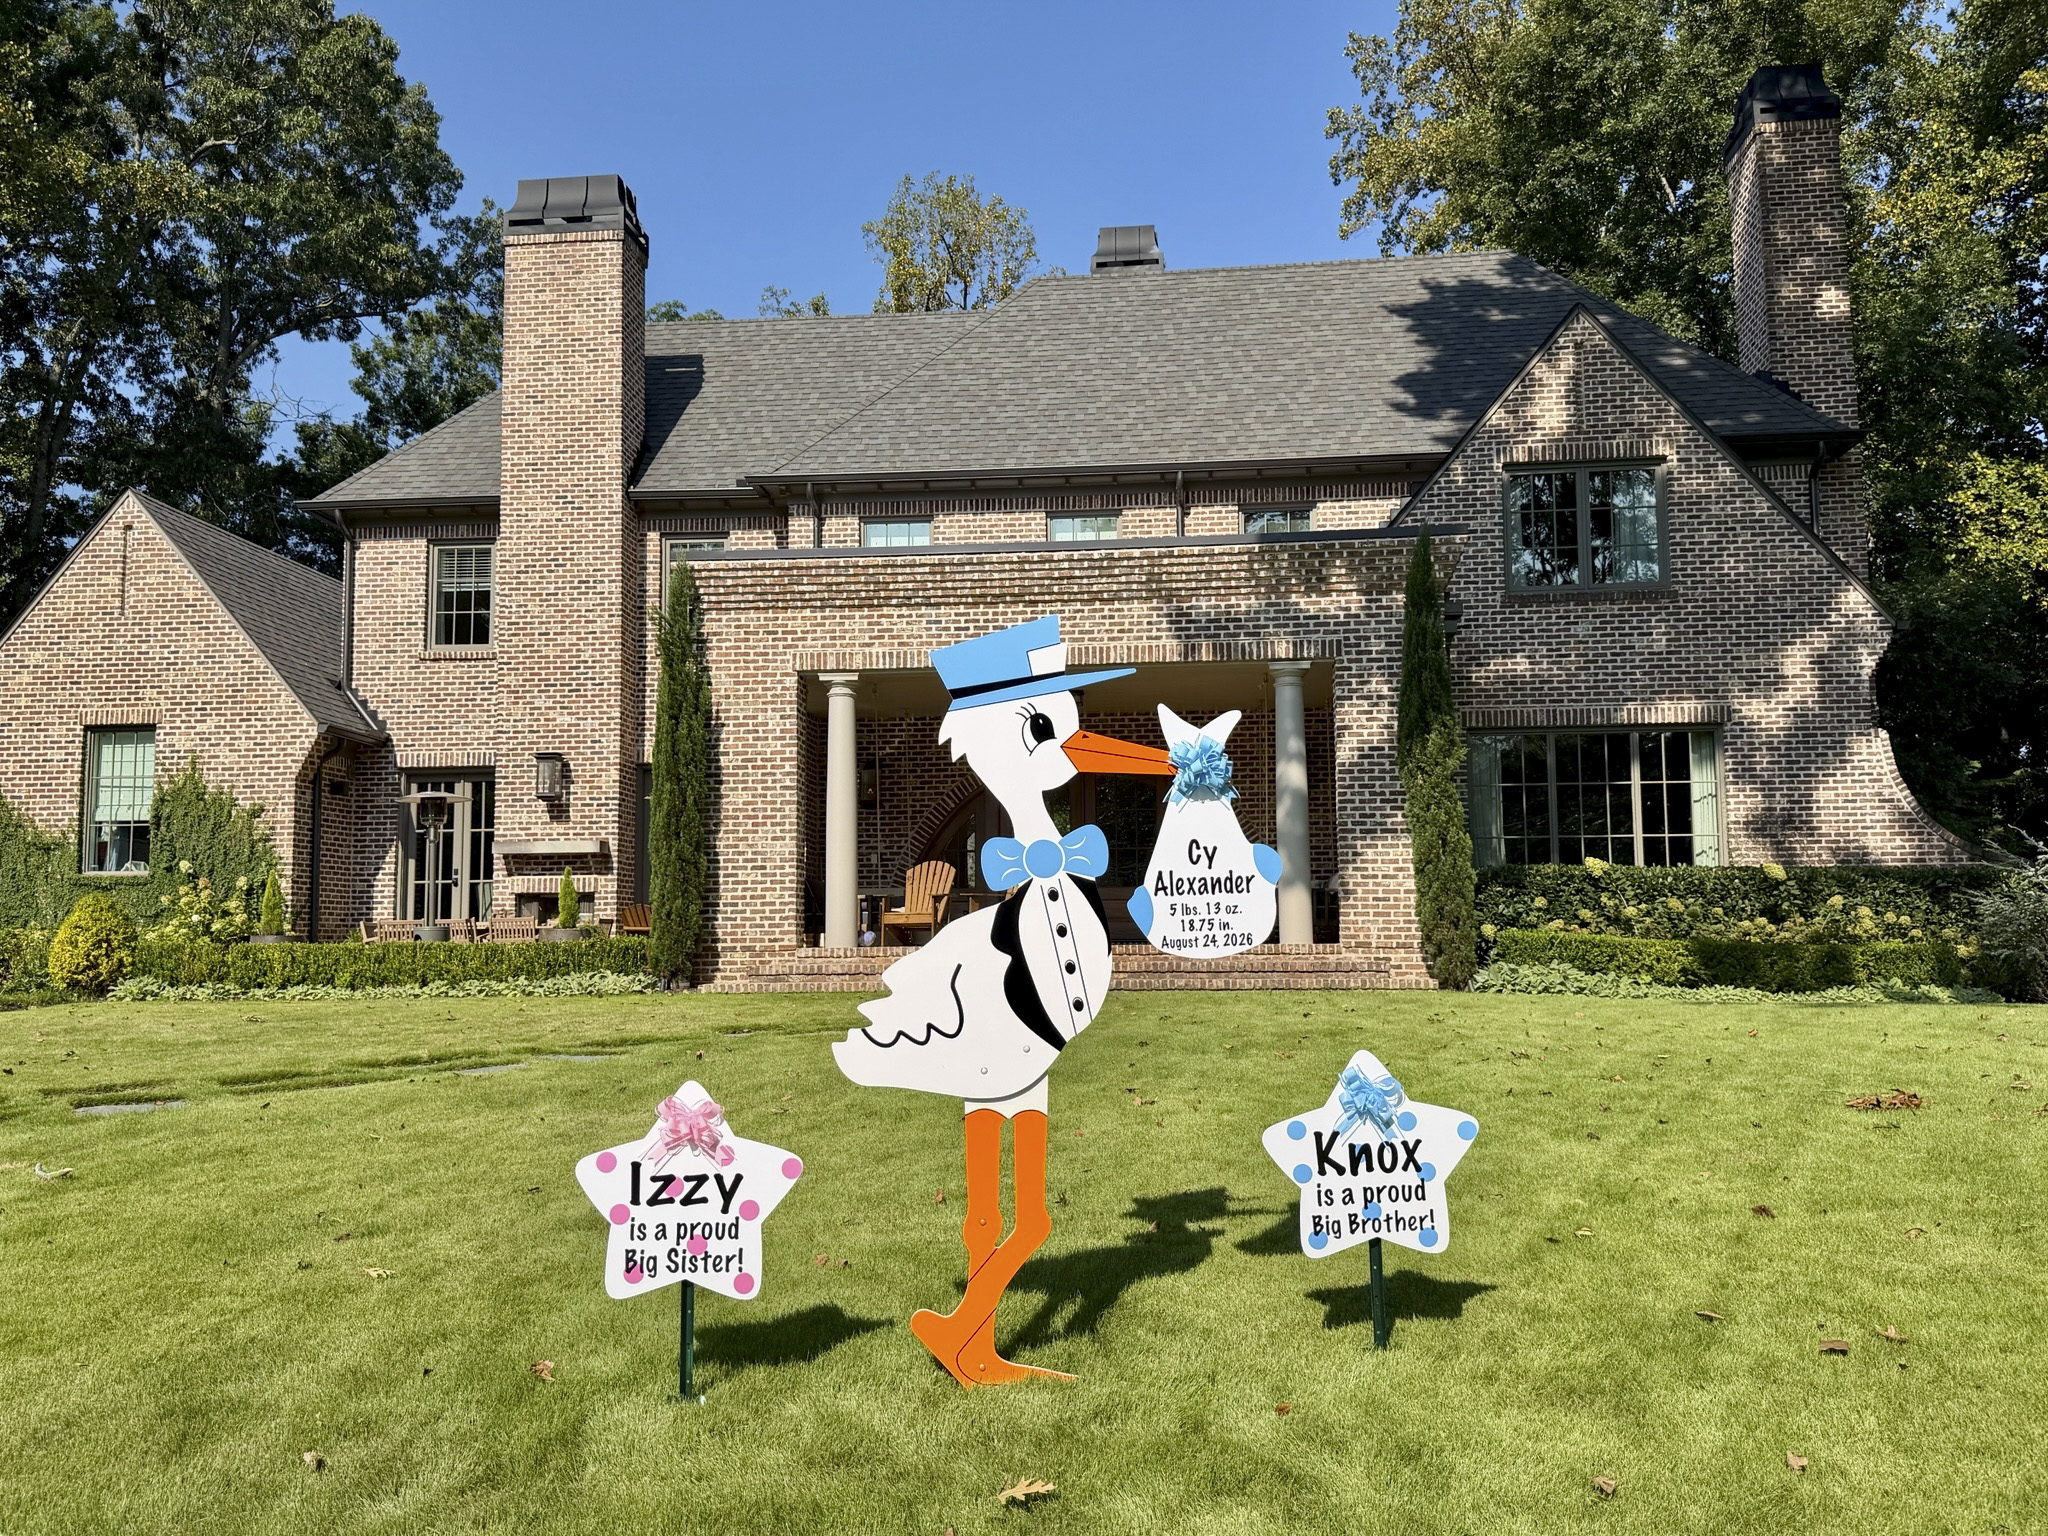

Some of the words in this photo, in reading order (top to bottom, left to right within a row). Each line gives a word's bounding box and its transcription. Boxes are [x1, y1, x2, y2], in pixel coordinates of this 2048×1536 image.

[1188, 839, 1218, 870] Cy
[1154, 870, 1255, 897] Alexander
[1169, 903, 1178, 917] 5
[1181, 903, 1201, 916] lbs.
[1206, 902, 1221, 915] 13
[1225, 904, 1243, 915] oz.
[1181, 918, 1215, 932] 18.75
[1219, 919, 1234, 931] in.
[1161, 935, 1199, 951] August
[1203, 934, 1219, 948] 24,
[1223, 933, 1253, 946] 2026
[1313, 1131, 1422, 1177] Knox
[629, 1161, 744, 1214] Izzy
[1316, 1183, 1334, 1207] is
[1341, 1188, 1355, 1205] a
[1362, 1178, 1426, 1210] proud
[629, 1217, 647, 1241] is
[654, 1222, 667, 1240] a
[676, 1216, 740, 1246] proud
[1312, 1215, 1342, 1239] Big
[1348, 1209, 1435, 1235] Brother!
[624, 1249, 658, 1278] Big
[665, 1247, 744, 1273] Sister!
